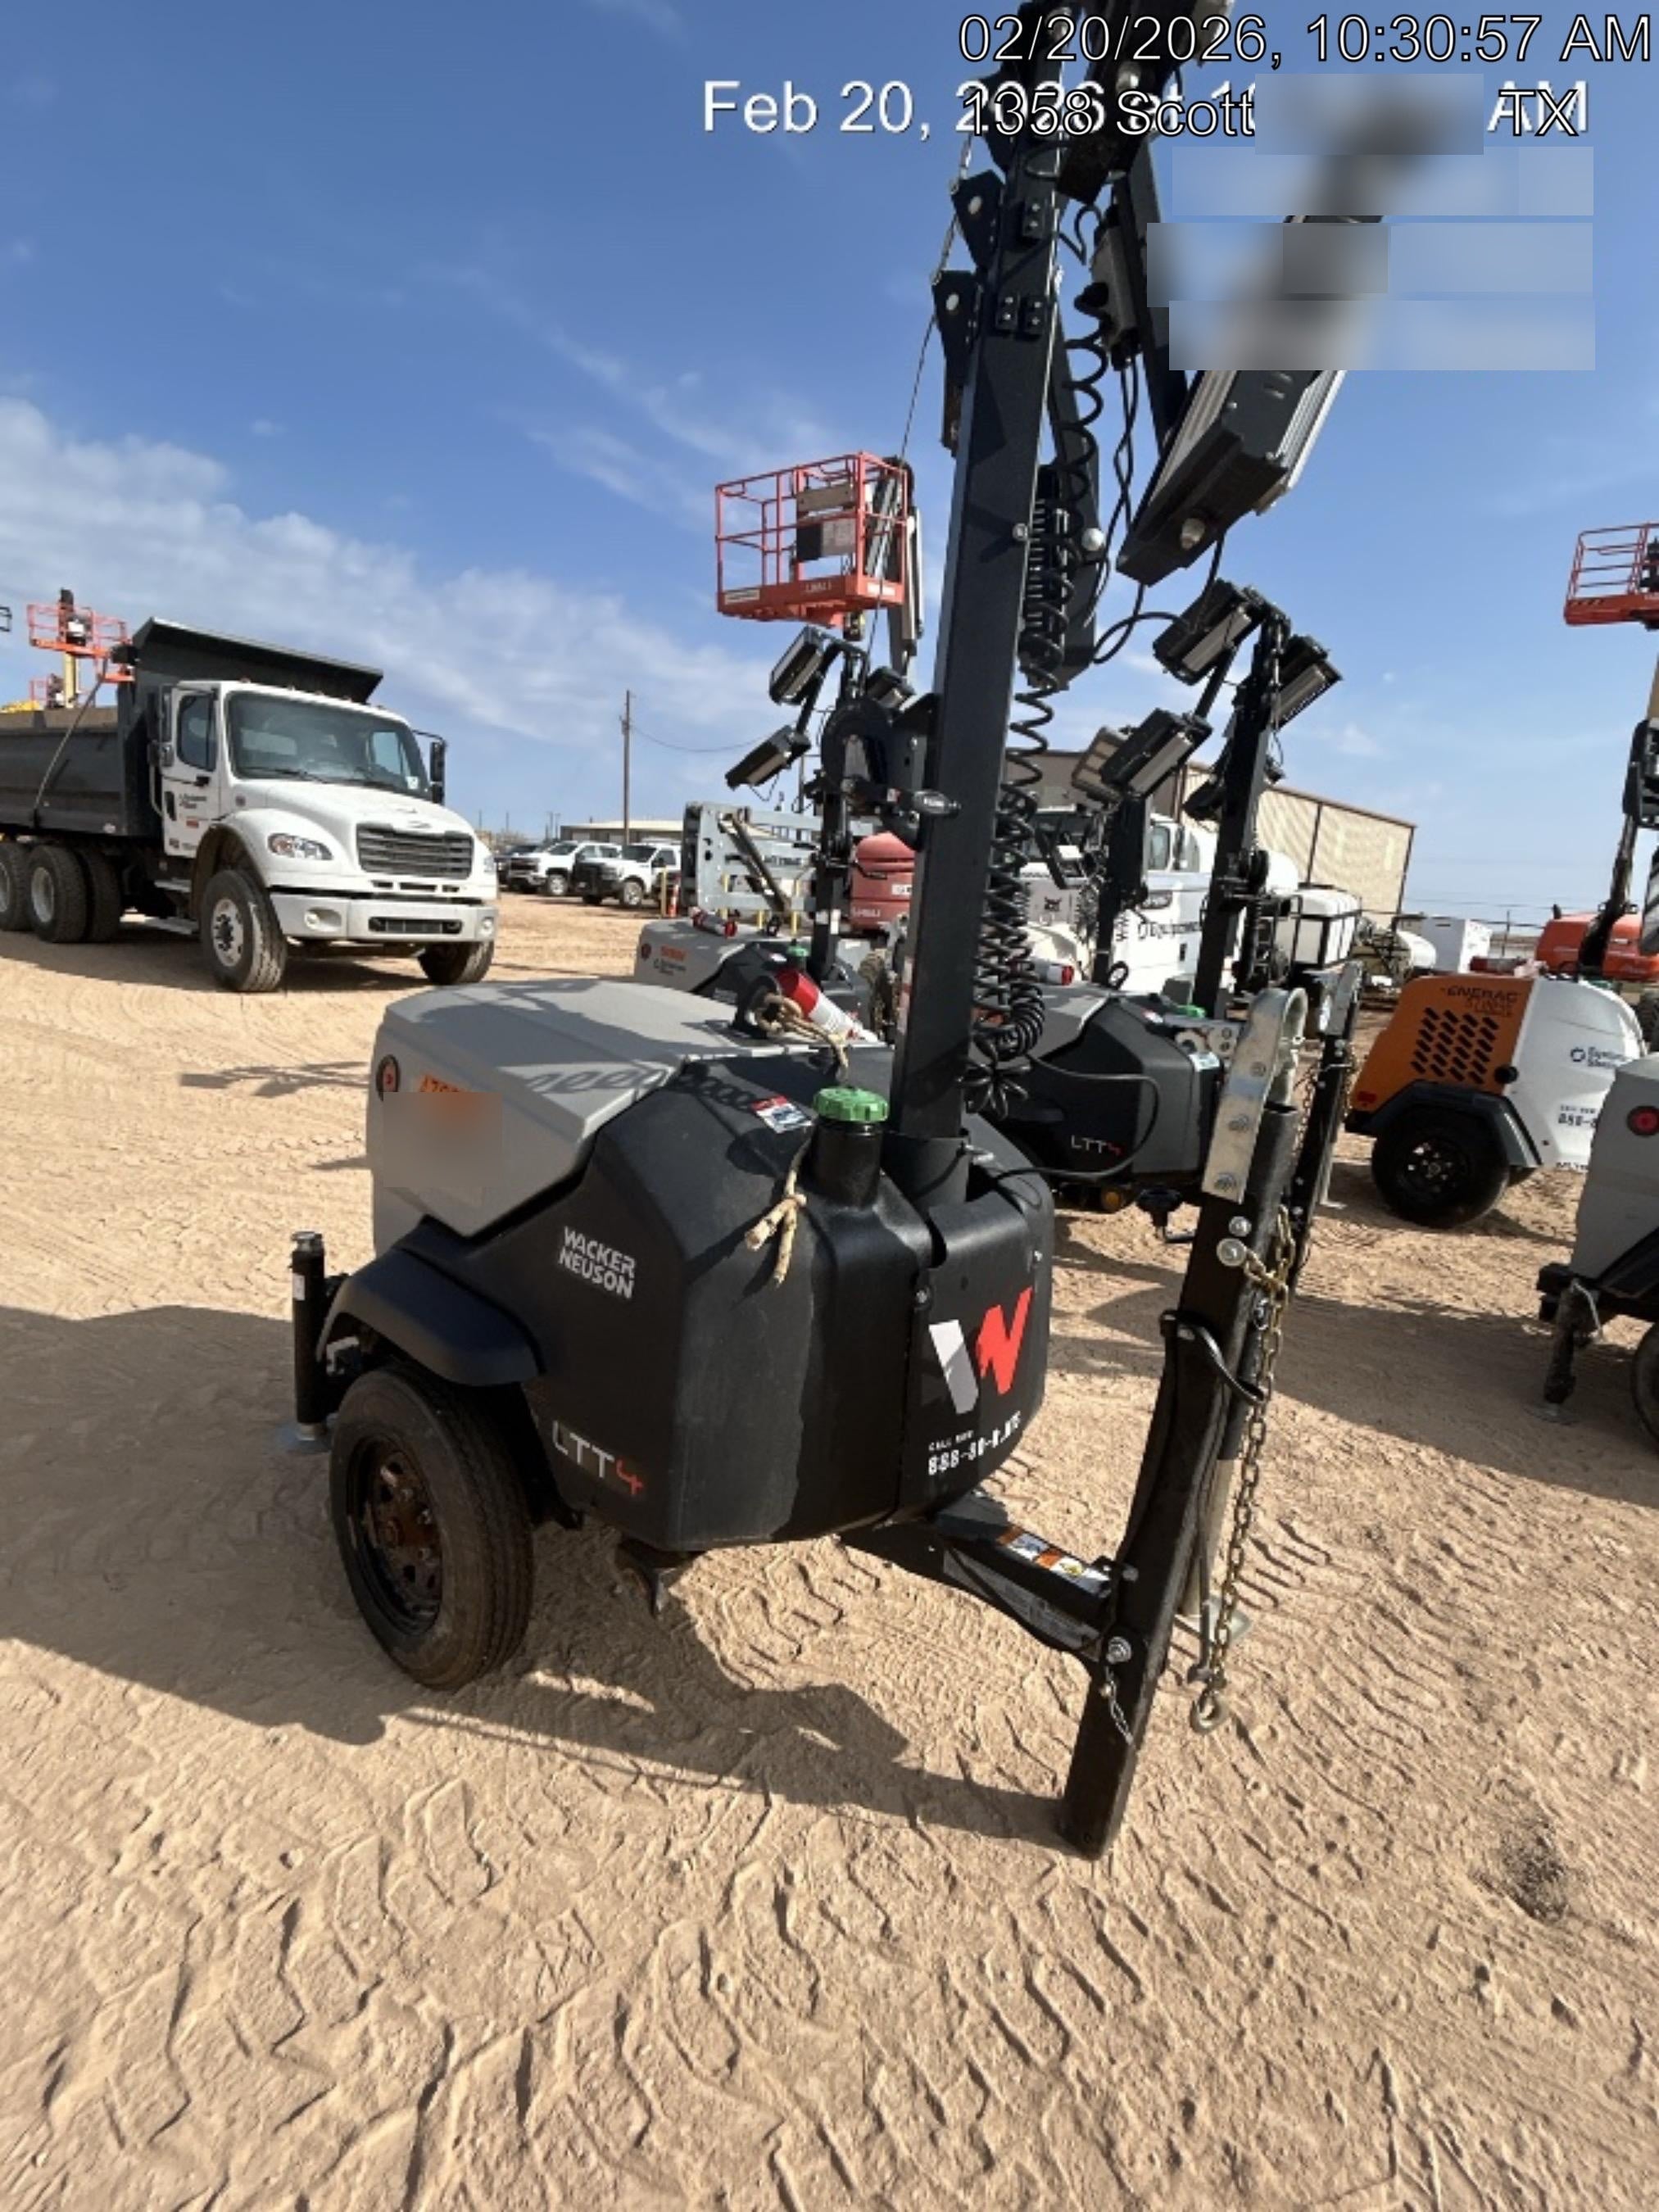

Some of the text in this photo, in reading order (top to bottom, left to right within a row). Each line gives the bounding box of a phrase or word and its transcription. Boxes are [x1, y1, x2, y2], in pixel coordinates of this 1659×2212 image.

[559, 1246, 636, 1299] NEUSON
[563, 1226, 636, 1279] WACKER
[551, 1420, 644, 1496] LTT4
